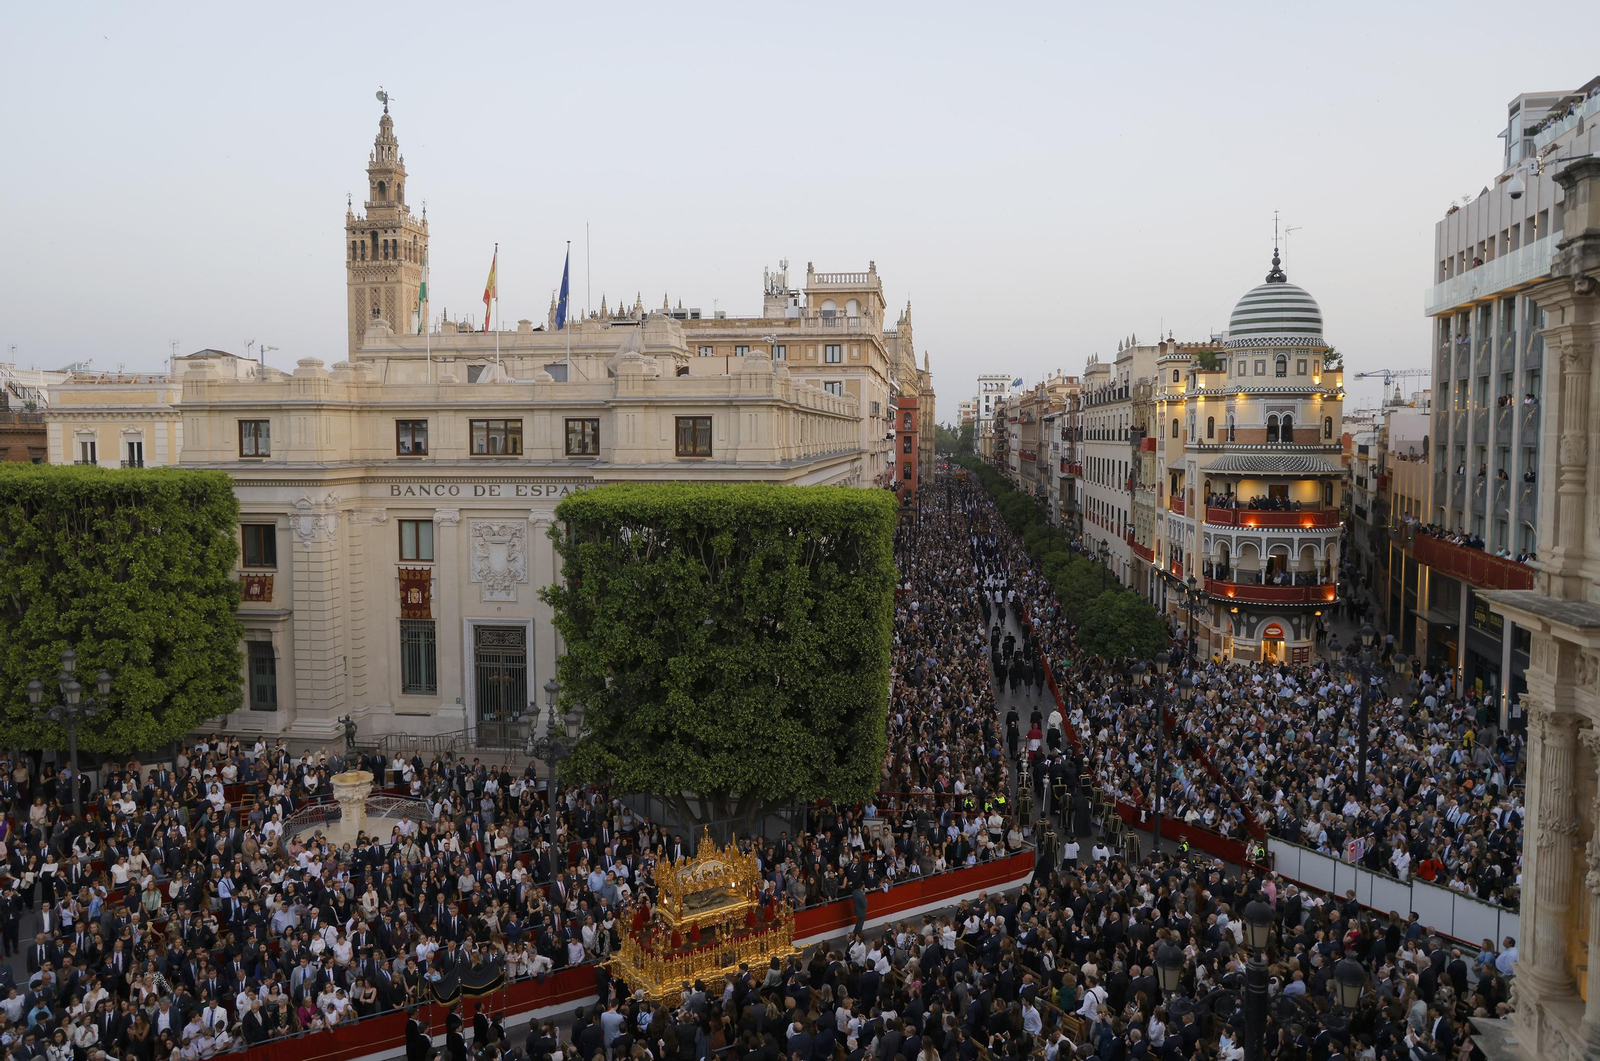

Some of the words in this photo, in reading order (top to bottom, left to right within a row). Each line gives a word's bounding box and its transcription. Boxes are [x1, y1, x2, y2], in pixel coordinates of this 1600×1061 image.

[390, 484, 460, 496] BANCO
[474, 484, 501, 496] DE
[515, 483, 597, 497] ESPAÑ
